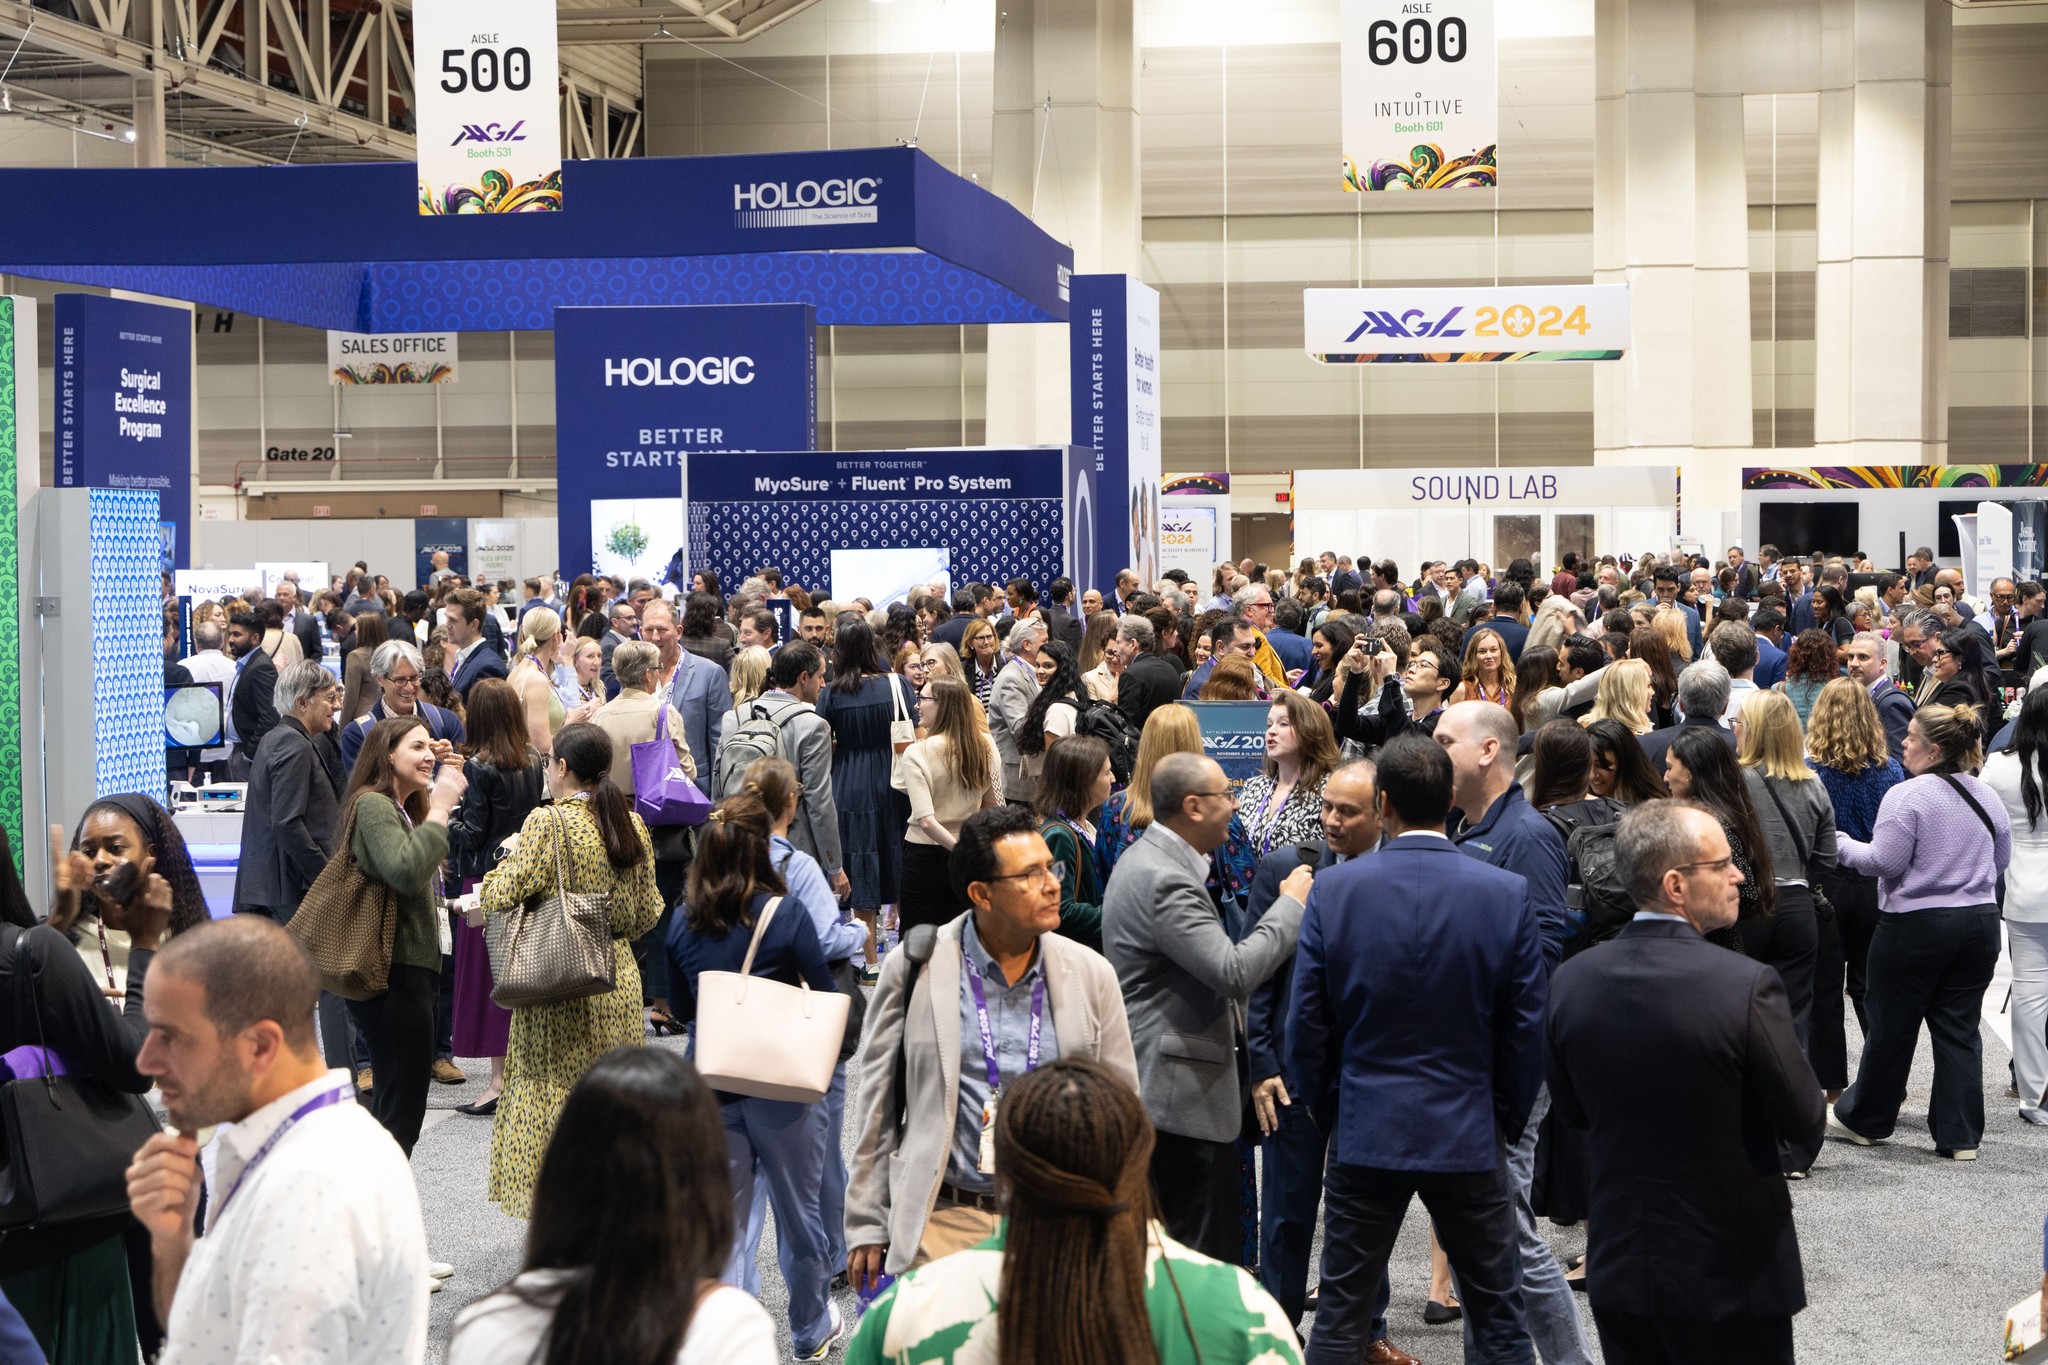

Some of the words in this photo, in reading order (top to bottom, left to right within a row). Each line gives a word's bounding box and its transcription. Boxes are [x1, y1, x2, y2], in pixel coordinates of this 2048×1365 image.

[1401, 3, 1432, 14] AISLE
[471, 33, 499, 44] AISLE
[1368, 16, 1467, 66] 600
[440, 46, 531, 94] 500
[1374, 99, 1463, 117] INTUITIVE
[450, 119, 528, 147] AAGL
[1394, 122, 1424, 133] Booth
[1426, 121, 1443, 132] 601
[467, 149, 495, 158] Booth
[496, 147, 512, 157] 531
[824, 212, 848, 220] Science
[857, 211, 872, 219] Sure
[1092, 308, 1102, 347] HERE
[1342, 306, 1467, 343] AAGL
[1474, 304, 1591, 338] 2024
[64, 327, 74, 365] HERE
[341, 339, 388, 354] SALES
[393, 337, 446, 353] OFFICE
[121, 367, 161, 393] Surgical
[605, 356, 755, 387] HOLOGIC
[1092, 352, 1103, 409] STARTS
[63, 371, 74, 425] STARTS
[115, 392, 166, 415] Excellence
[120, 417, 161, 441] Program
[639, 428, 723, 445] BETTER
[63, 431, 74, 485] BETTER
[266, 447, 308, 461] Gate
[311, 447, 335, 460] 20
[836, 461, 871, 469] BETTER
[109, 474, 130, 489] Making
[131, 474, 147, 487] better
[914, 476, 944, 490] Pro
[948, 475, 1012, 493] System
[1411, 475, 1500, 500] SOUND
[1508, 475, 1558, 499] LAB
[188, 585, 247, 594] NovaSure
[977, 1008, 991, 1035] 2024
[1028, 1038, 1039, 1065] 2024
